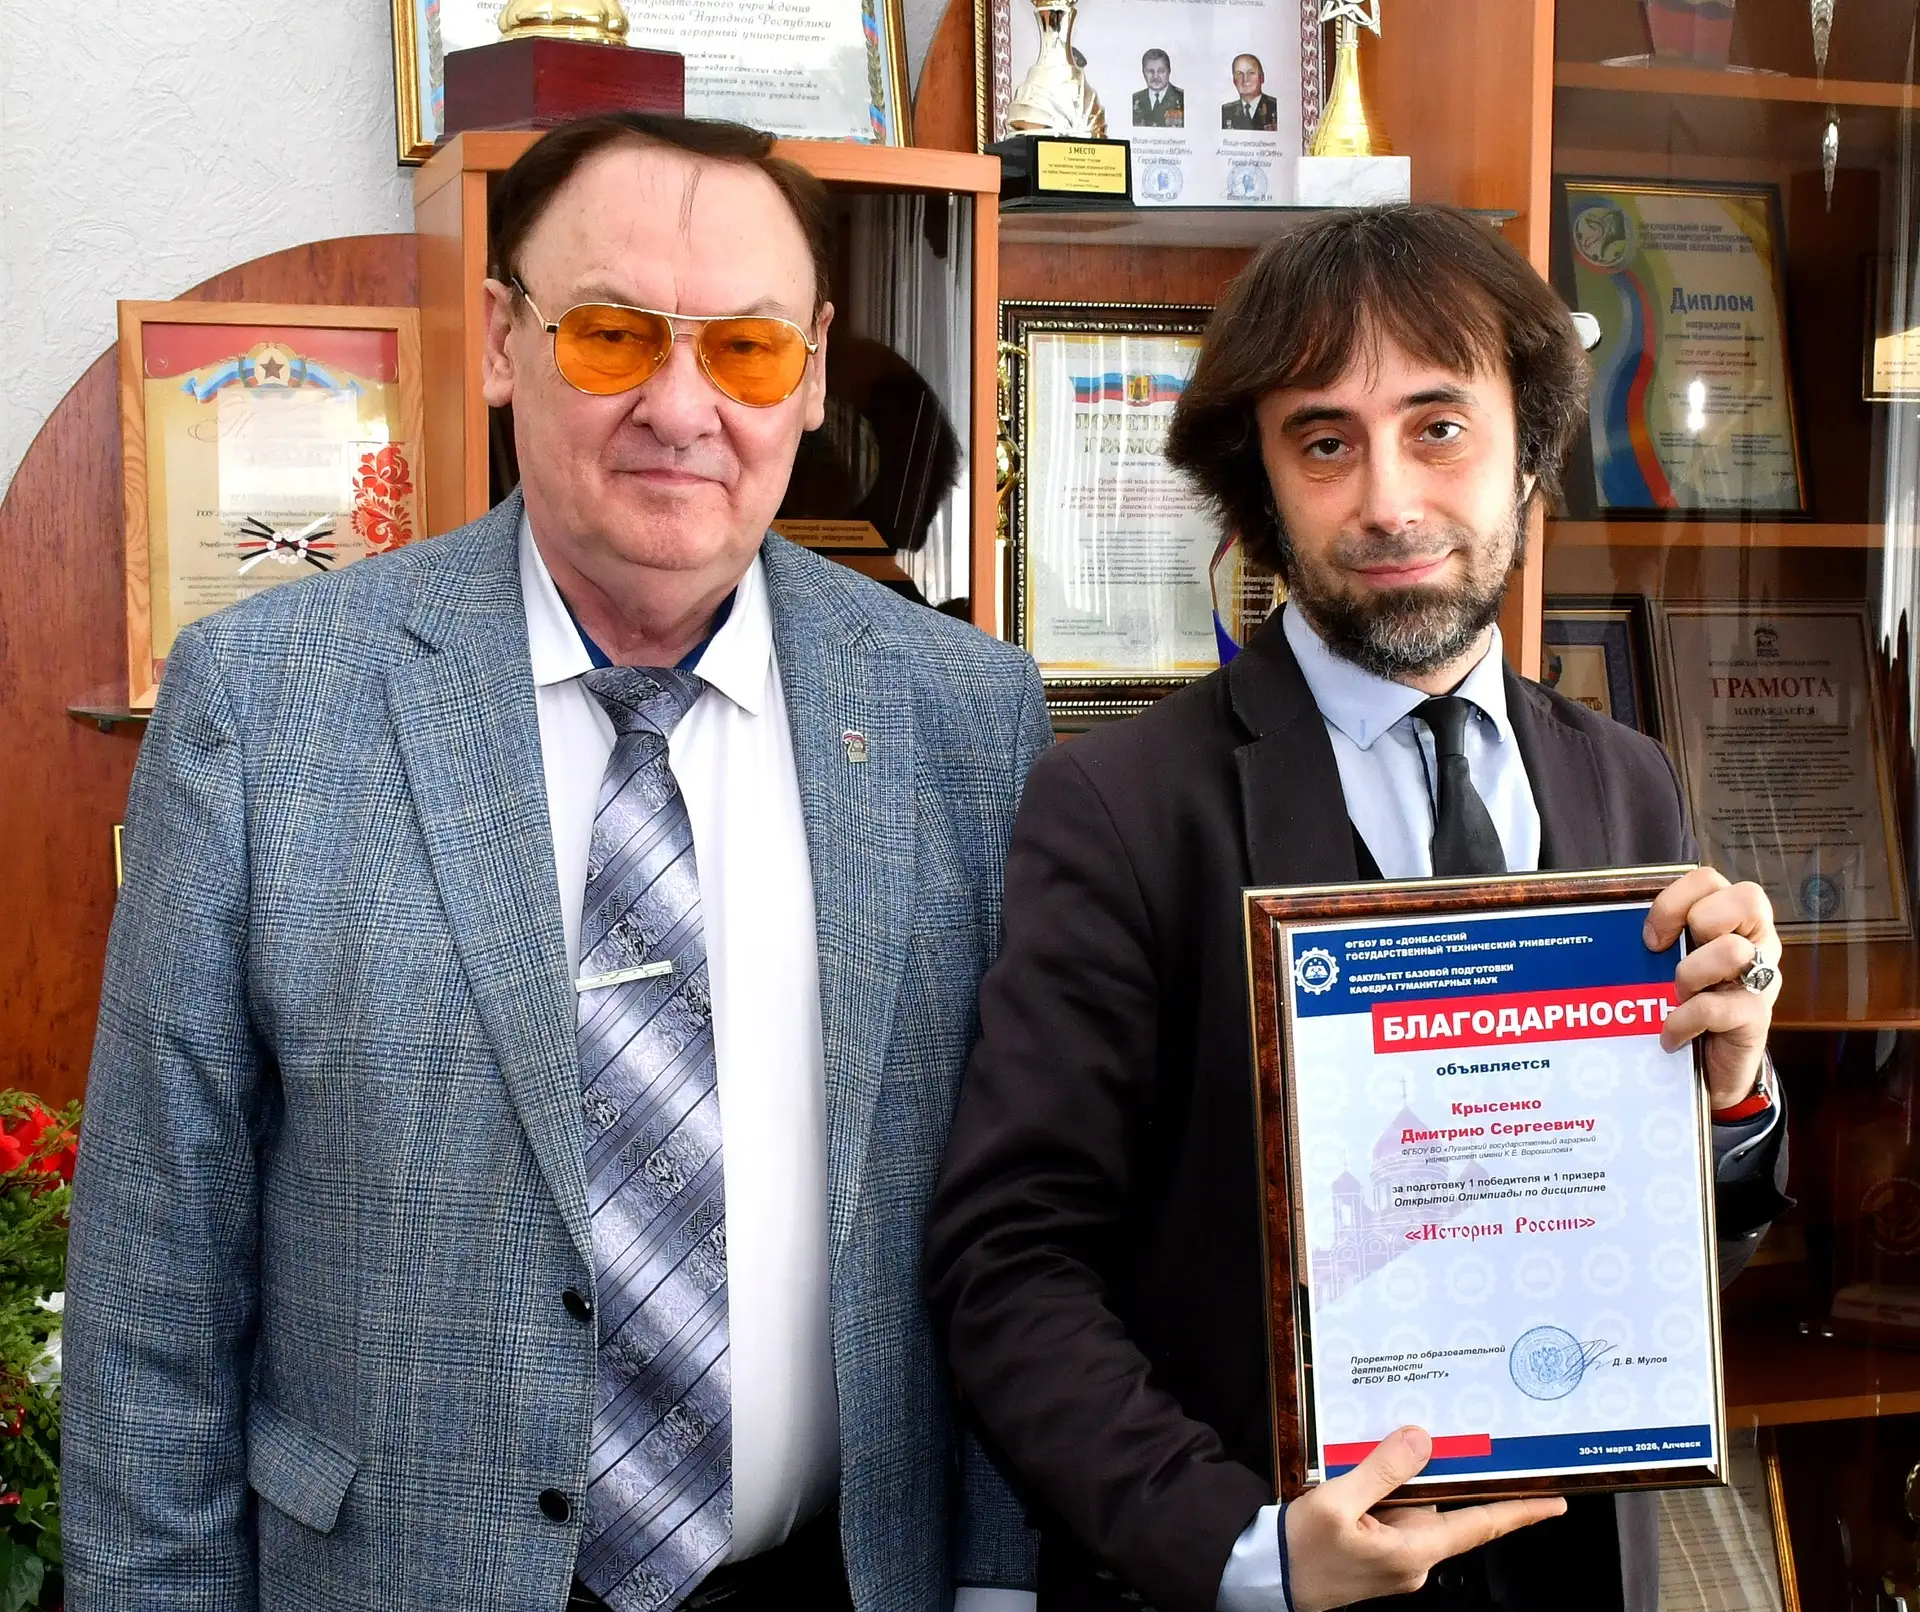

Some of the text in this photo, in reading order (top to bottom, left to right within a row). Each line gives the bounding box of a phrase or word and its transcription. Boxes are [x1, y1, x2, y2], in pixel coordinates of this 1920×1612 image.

[690, 9, 754, 25] Народной
[758, 12, 832, 31] Республики
[680, 28, 737, 39] аграрный
[1074, 147, 1096, 155] МЕСТО
[1670, 288, 1754, 315] Диплом
[1075, 412, 1168, 431] ПОЧЕТН
[1084, 437, 1161, 455] ГРАМО
[1709, 677, 1834, 698] ГРАМОТА
[1734, 707, 1815, 716] НАГРАЖДАЕТСЯ
[1345, 932, 1467, 949] ФГБОУ ВО «ДОНБАССКИЙ
[1345, 935, 1593, 961] ГОСУДАРСТВЕННЫЙ ТЕХНИЧЕСКИЙ УНИВЕРСИТЕТ»
[1349, 963, 1514, 983] ФАКУЛЬТЕТ БАЗОВОЙ ПОДГОТОВКИ
[1350, 976, 1498, 994] КАФЕДРА ГУМАНИТАРНЫХ НАУК
[1436, 1058, 1551, 1077] объявляется
[1451, 1100, 1541, 1117] Крысенко
[1401, 1118, 1595, 1144] Дмитрию Сергеевичу
[1401, 1135, 1597, 1156] ФГБОУ ВО «Луганский государственный аграрный
[1479, 1151, 1502, 1159] имени
[1521, 1146, 1573, 1157] Ворошилова»
[1392, 1186, 1404, 1194] за
[1406, 1181, 1466, 1193] подготовку
[1469, 1180, 1475, 1188] 1
[1477, 1175, 1541, 1187] победителя
[1553, 1173, 1558, 1181] 1
[1562, 1171, 1606, 1183] призера
[1394, 1184, 1606, 1207] Открытой Олимпиады по дисциплине
[1350, 1353, 1404, 1365] Проректор
[1420, 1345, 1506, 1358] образовательной
[1612, 1356, 1668, 1367] Д. В. Мулов
[1351, 1362, 1423, 1375] деятельности
[1352, 1370, 1449, 1385] ФГБОУ ВО «ДонГТУ»
[1579, 1446, 1604, 1456] 30-31
[1606, 1445, 1633, 1455] марта
[1662, 1440, 1701, 1450] Алчевск
